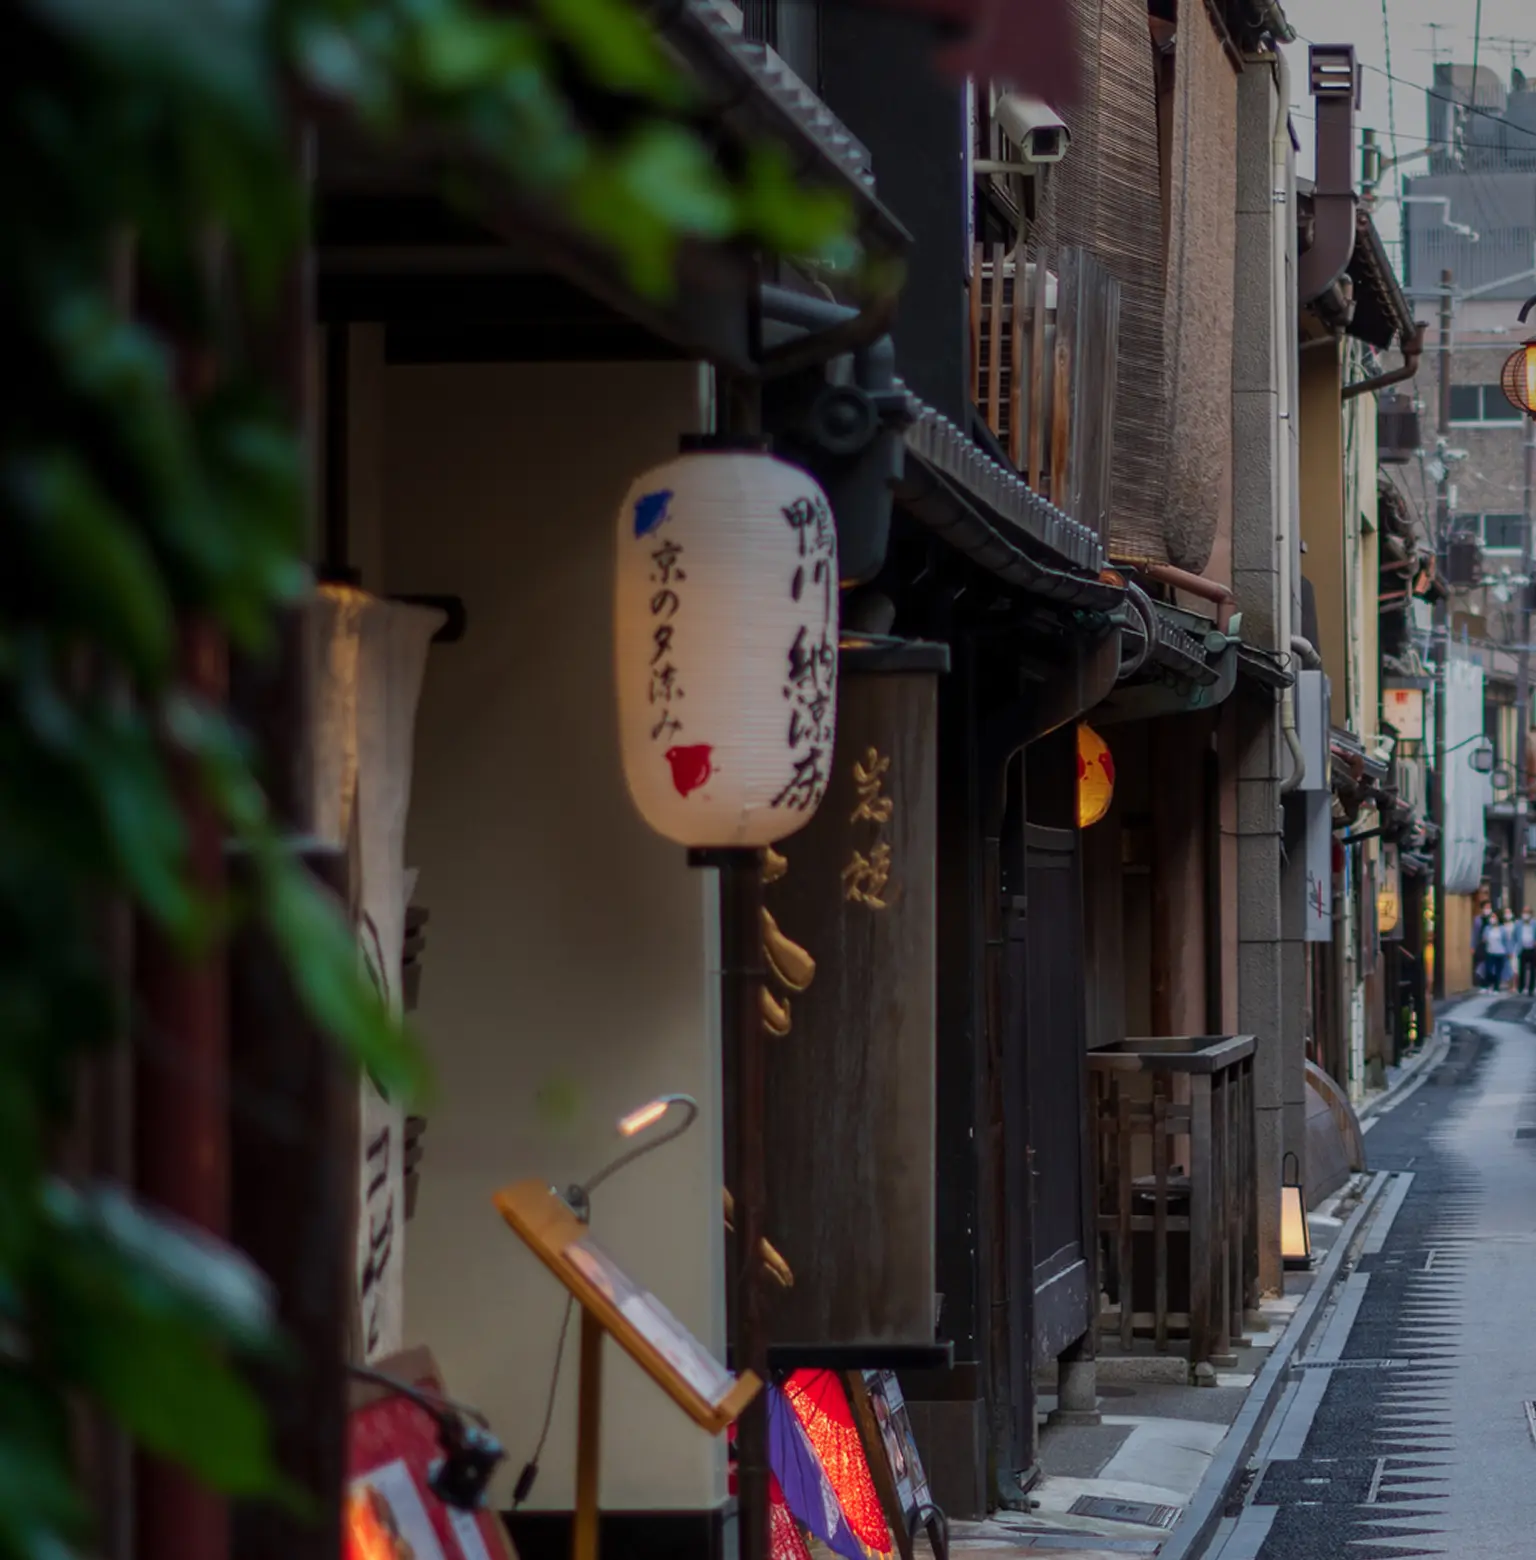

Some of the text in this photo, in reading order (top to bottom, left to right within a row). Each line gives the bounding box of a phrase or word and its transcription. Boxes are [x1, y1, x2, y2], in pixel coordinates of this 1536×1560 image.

[648, 540, 687, 743] 京の夕涼み
